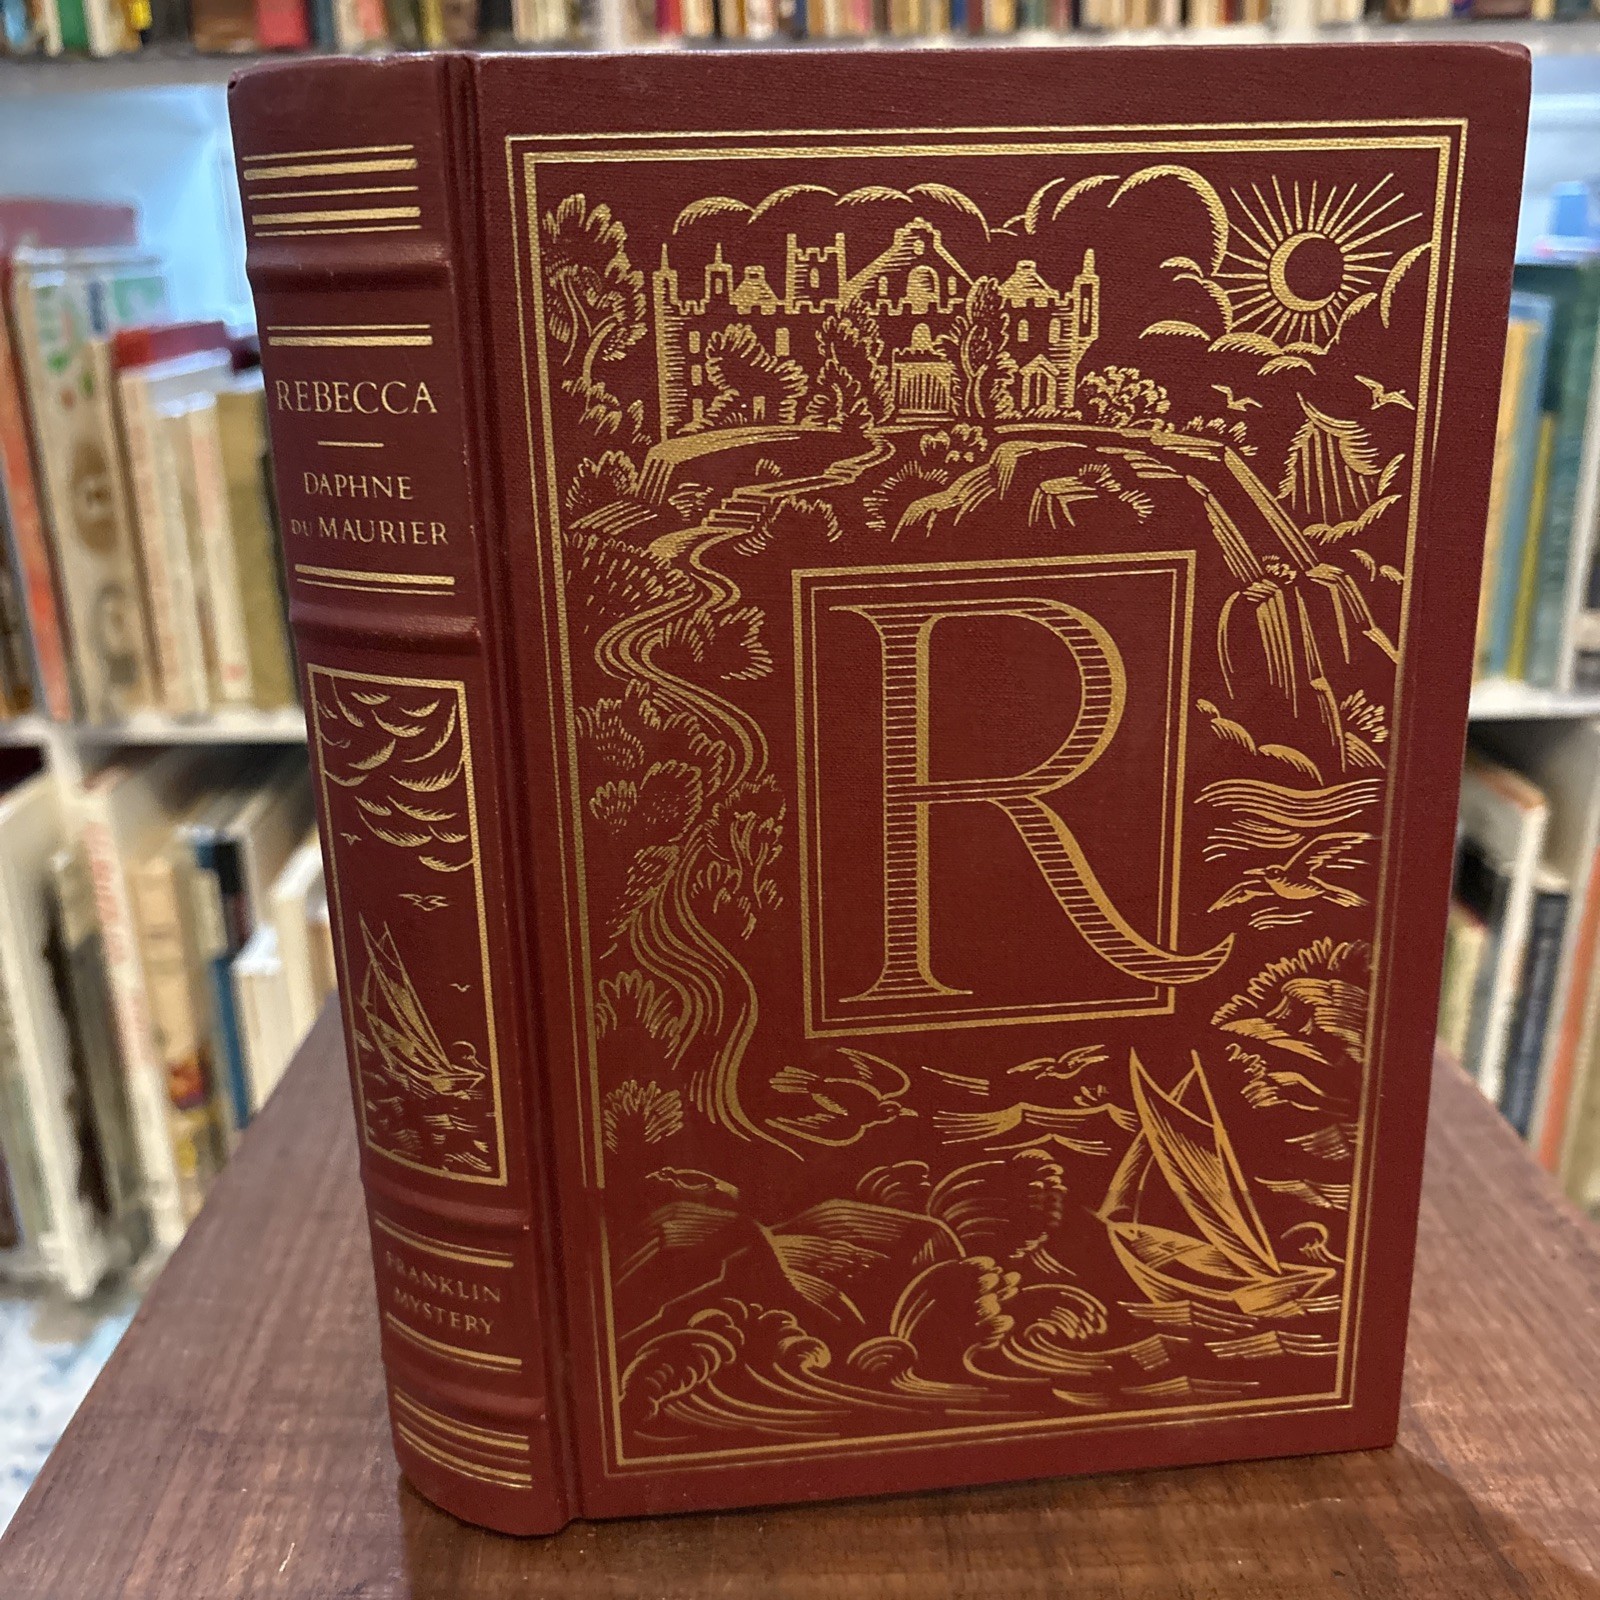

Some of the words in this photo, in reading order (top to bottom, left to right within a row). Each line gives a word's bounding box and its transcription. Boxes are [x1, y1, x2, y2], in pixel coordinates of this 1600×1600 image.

[275, 380, 438, 414] REBECCA
[303, 472, 414, 500] DAPHNE
[291, 519, 312, 537] DU
[317, 517, 449, 545] MAURIER
[829, 597, 1236, 1003] R
[394, 1286, 494, 1335] MYSTERY
